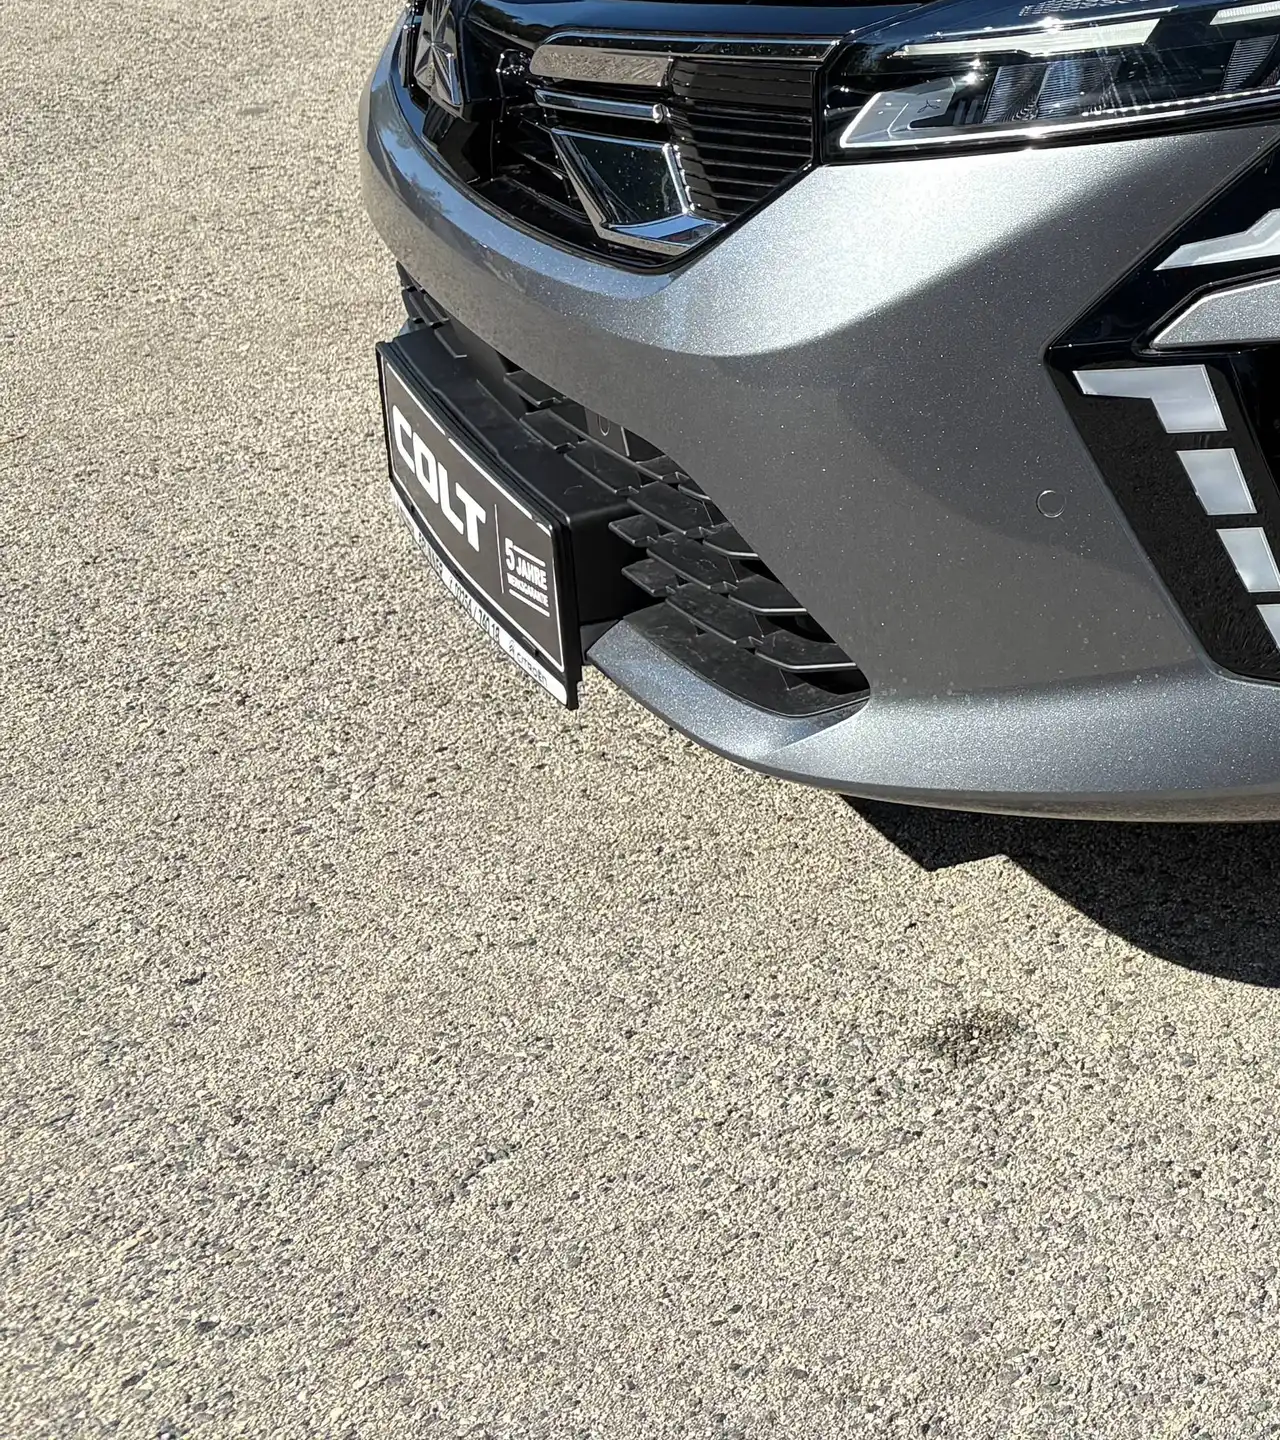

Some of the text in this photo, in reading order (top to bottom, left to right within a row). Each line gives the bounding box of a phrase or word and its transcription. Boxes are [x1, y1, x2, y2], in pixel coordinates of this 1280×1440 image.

[392, 404, 487, 552] COLT
[505, 537, 548, 591] 5 JAHRE
